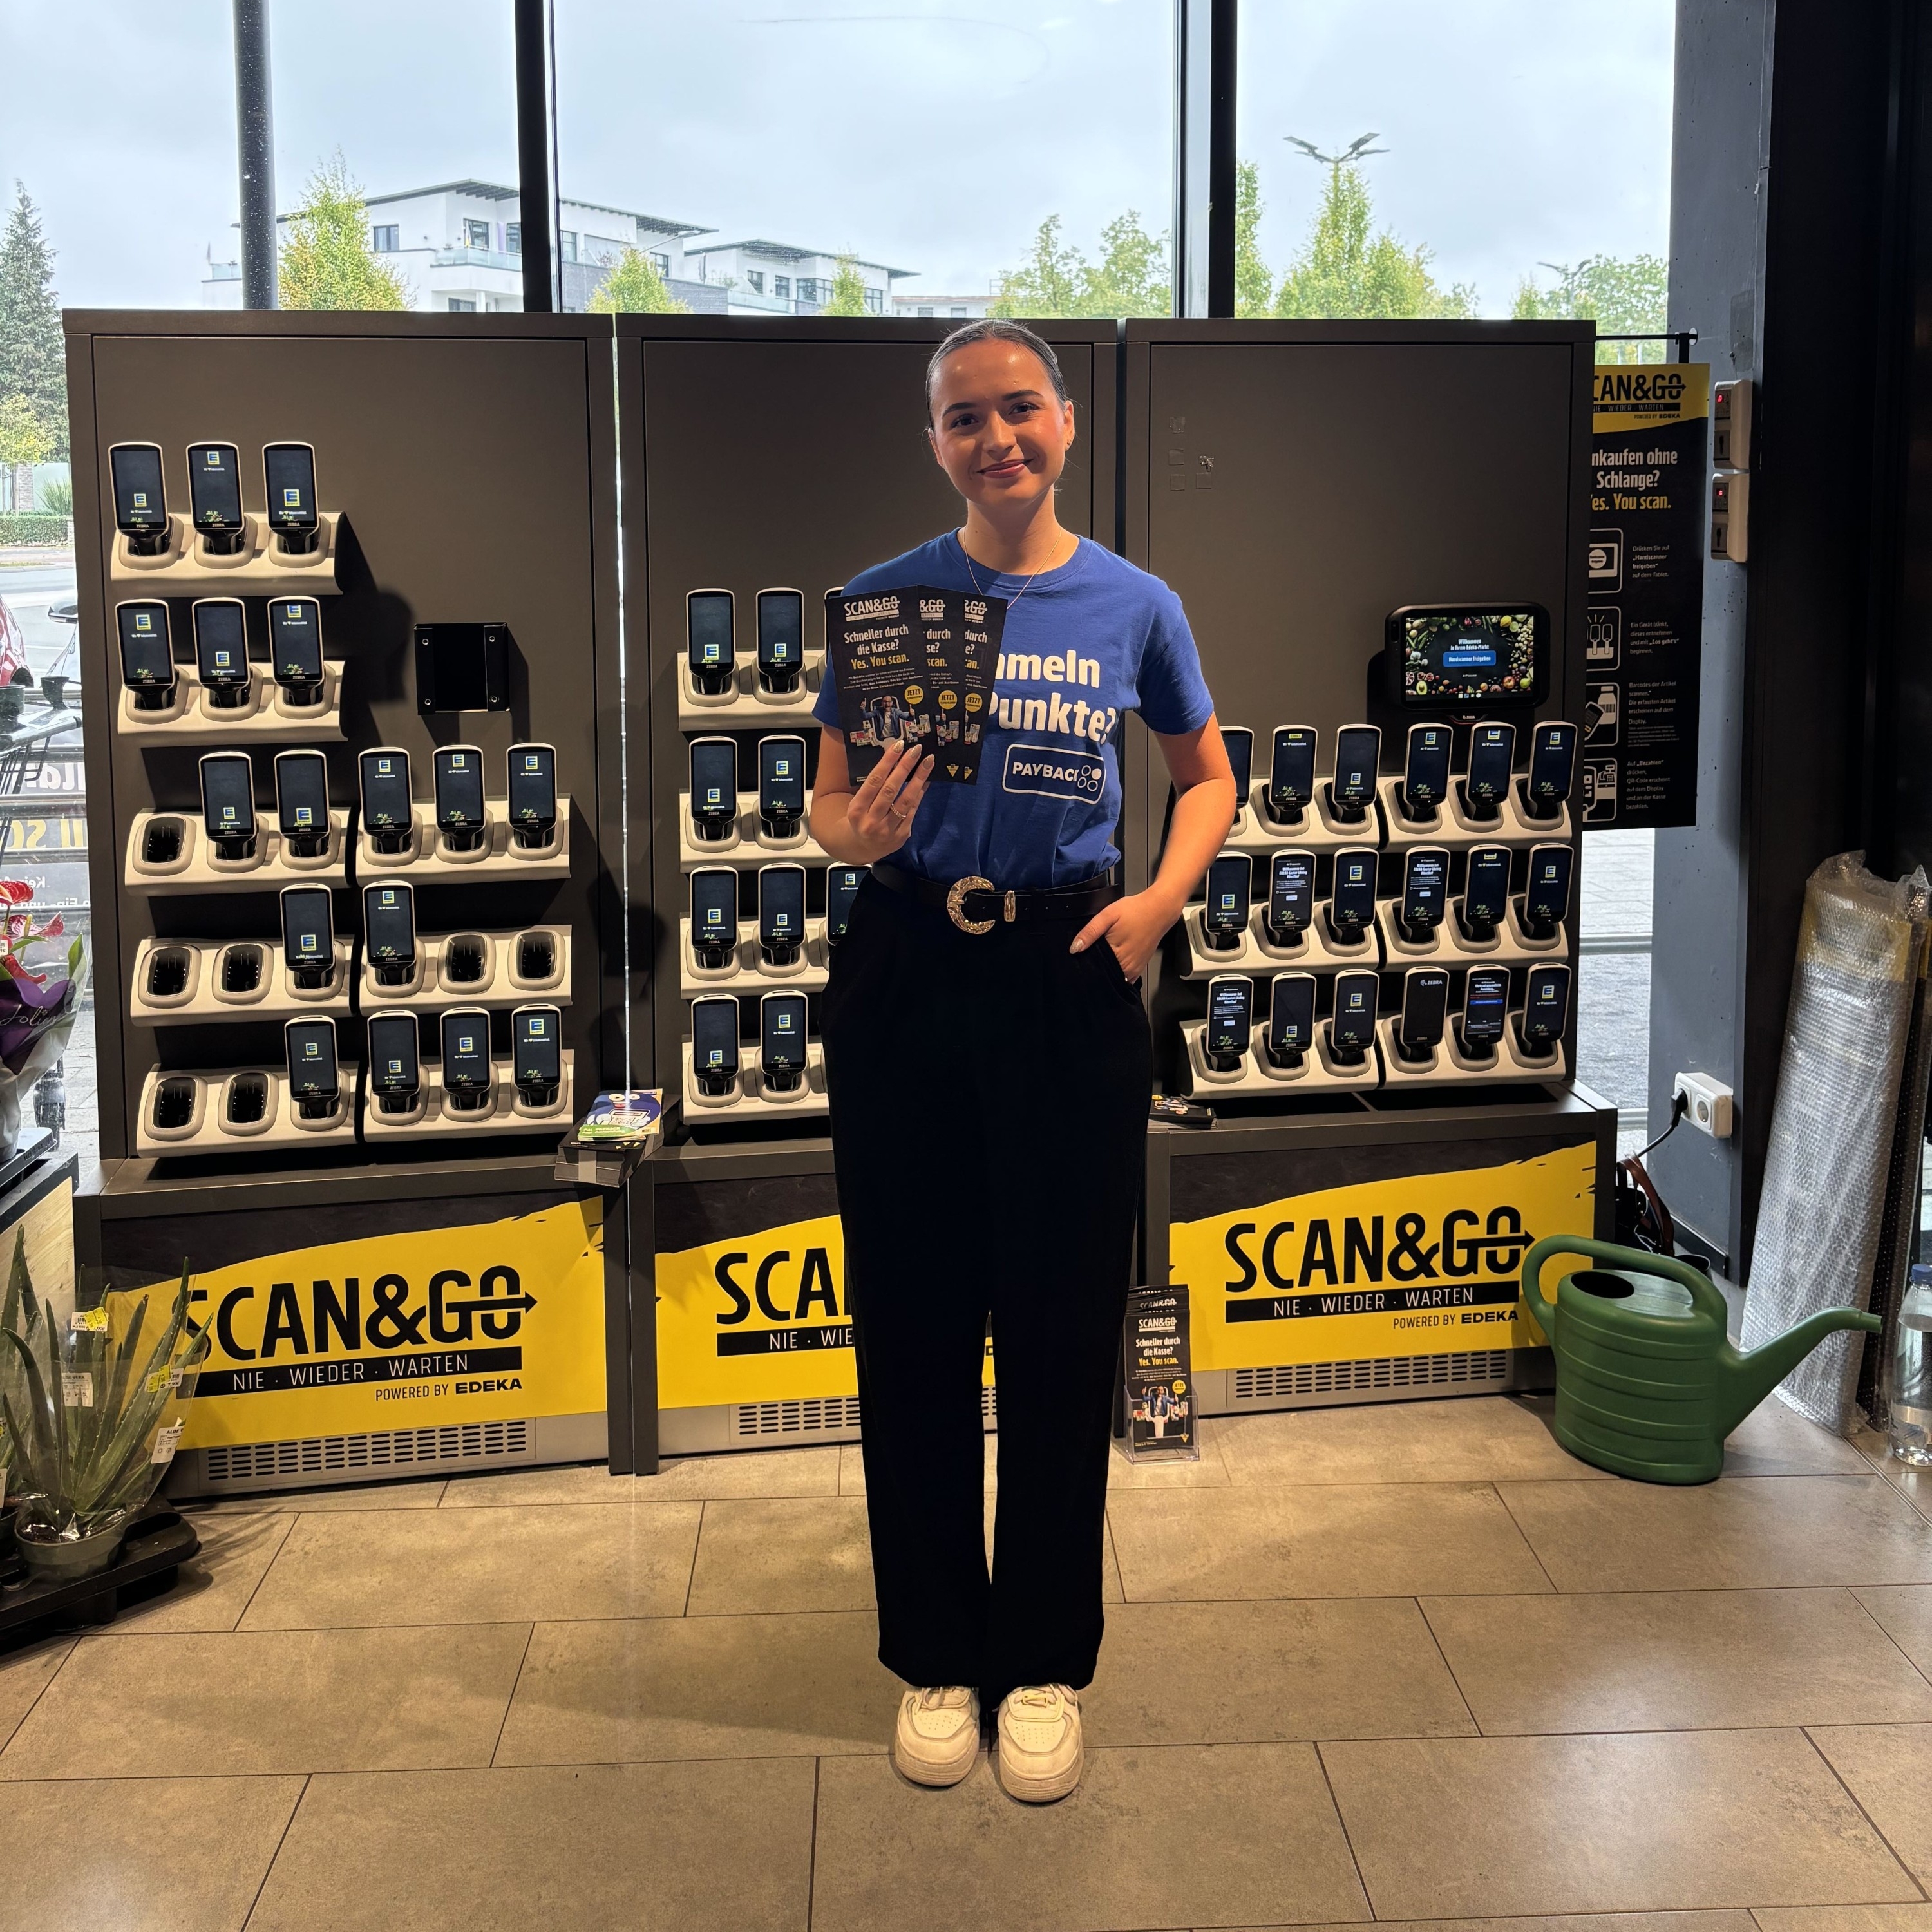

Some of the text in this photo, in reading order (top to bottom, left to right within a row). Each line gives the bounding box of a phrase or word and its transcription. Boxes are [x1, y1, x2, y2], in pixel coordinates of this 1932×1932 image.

[1591, 448, 1678, 466] nkaufen ohne
[1596, 470, 1660, 491] Schlange?
[1591, 493, 1672, 511] es. You scan.
[844, 596, 900, 616] SCAN&GO
[844, 623, 909, 643] Schneller durch
[927, 629, 951, 639] durch
[857, 639, 900, 656] die Kasse?
[926, 642, 940, 653] se?
[851, 654, 909, 670] Yes. You scan.
[965, 659, 980, 670] an.
[1224, 1205, 1535, 1293] SCAN&GO
[1274, 1287, 1473, 1317] NIE WIEDER WARTEN
[171, 1265, 537, 1363] SCAN&GO
[1139, 1316, 1177, 1329] SCAN&GO
[1393, 1310, 1519, 1329] POWERED BY EDEKA
[770, 1328, 853, 1350] NIE WIE
[1135, 1336, 1180, 1347] Schneller durch
[1143, 1346, 1173, 1356] die Kasse?
[1139, 1356, 1179, 1367] Yes. You scan.
[232, 1354, 469, 1391] NIE WIEDER WARTEN
[375, 1378, 522, 1401] POWERED BY EDEKA
